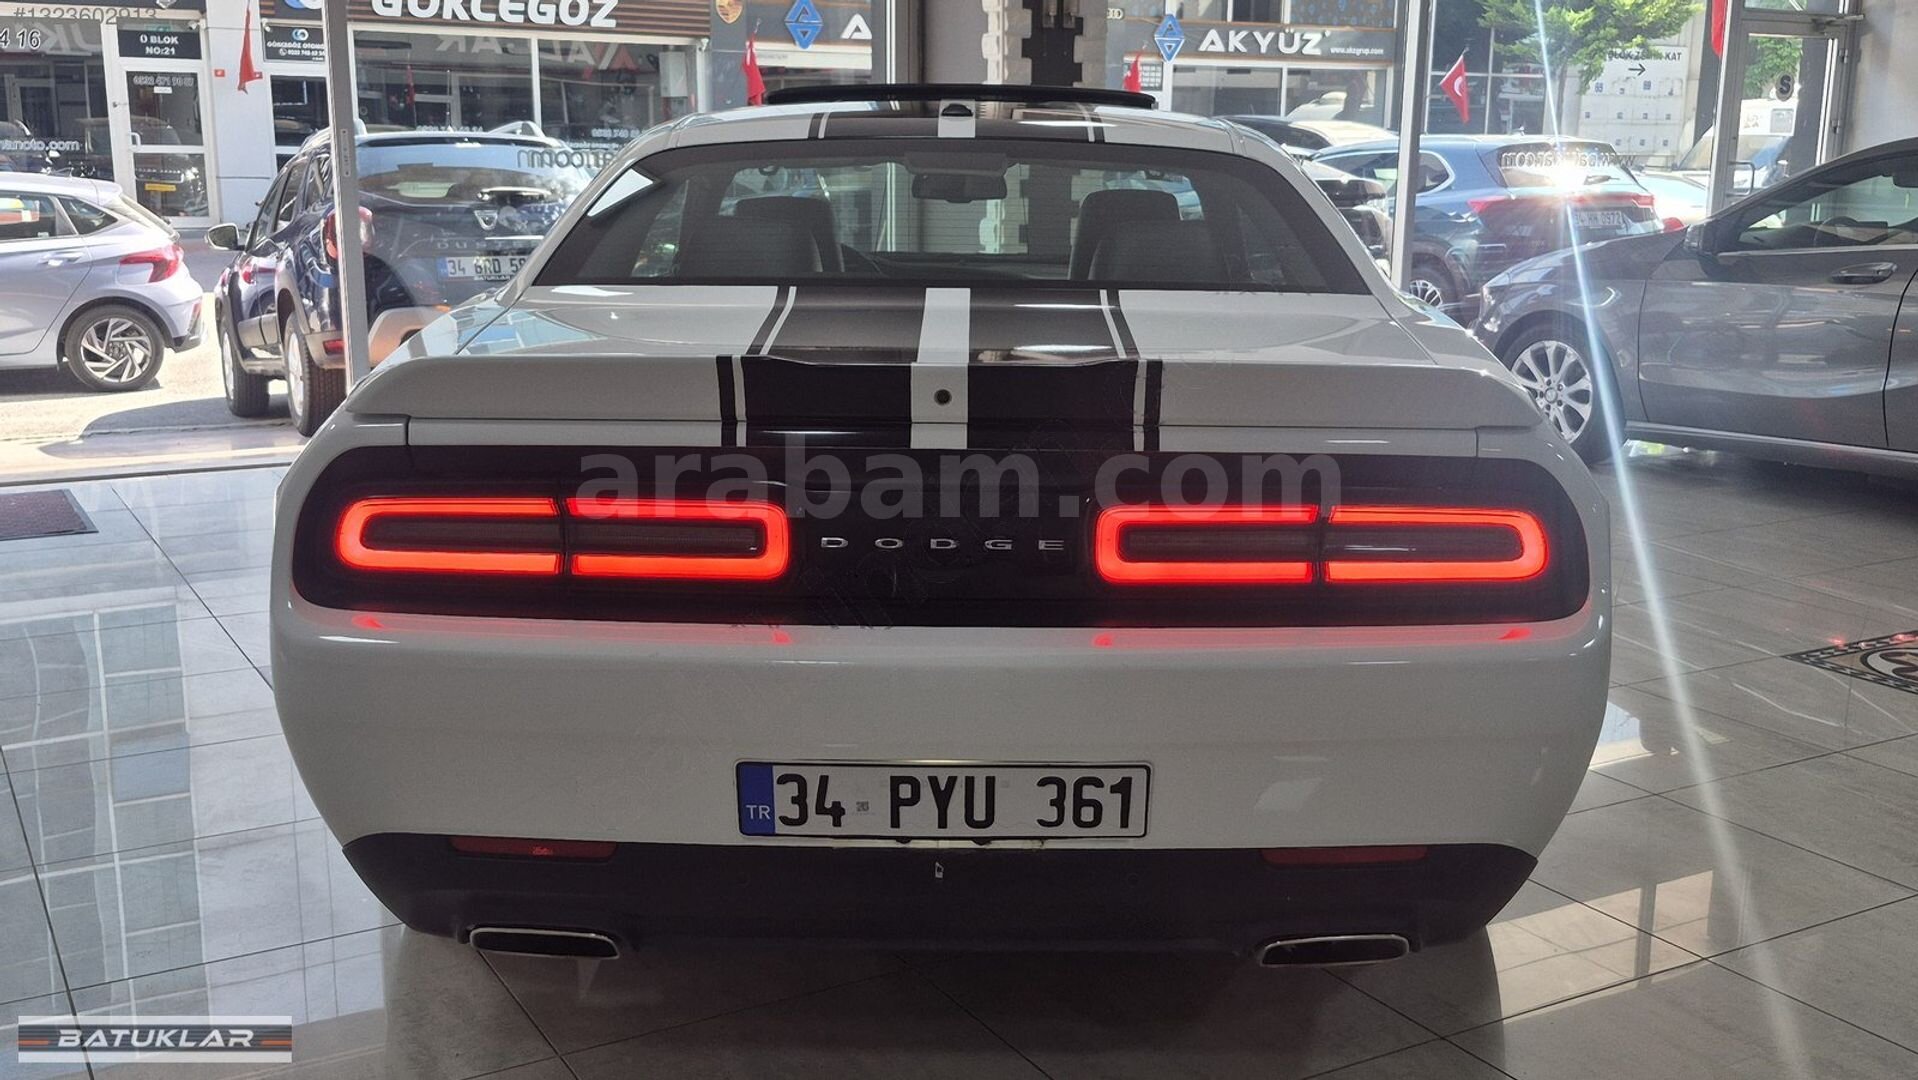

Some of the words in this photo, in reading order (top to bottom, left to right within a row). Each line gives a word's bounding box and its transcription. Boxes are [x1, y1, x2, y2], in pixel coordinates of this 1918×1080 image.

[150, 36, 179, 45] BLOK
[1199, 28, 1324, 55] AKYÜZ
[1664, 51, 1682, 60] KAT
[447, 260, 466, 275] 34
[820, 536, 1065, 552] DODGE
[776, 773, 846, 827] 34
[889, 776, 995, 829] PYU
[1036, 776, 1133, 829] 361
[746, 805, 771, 820] TR
